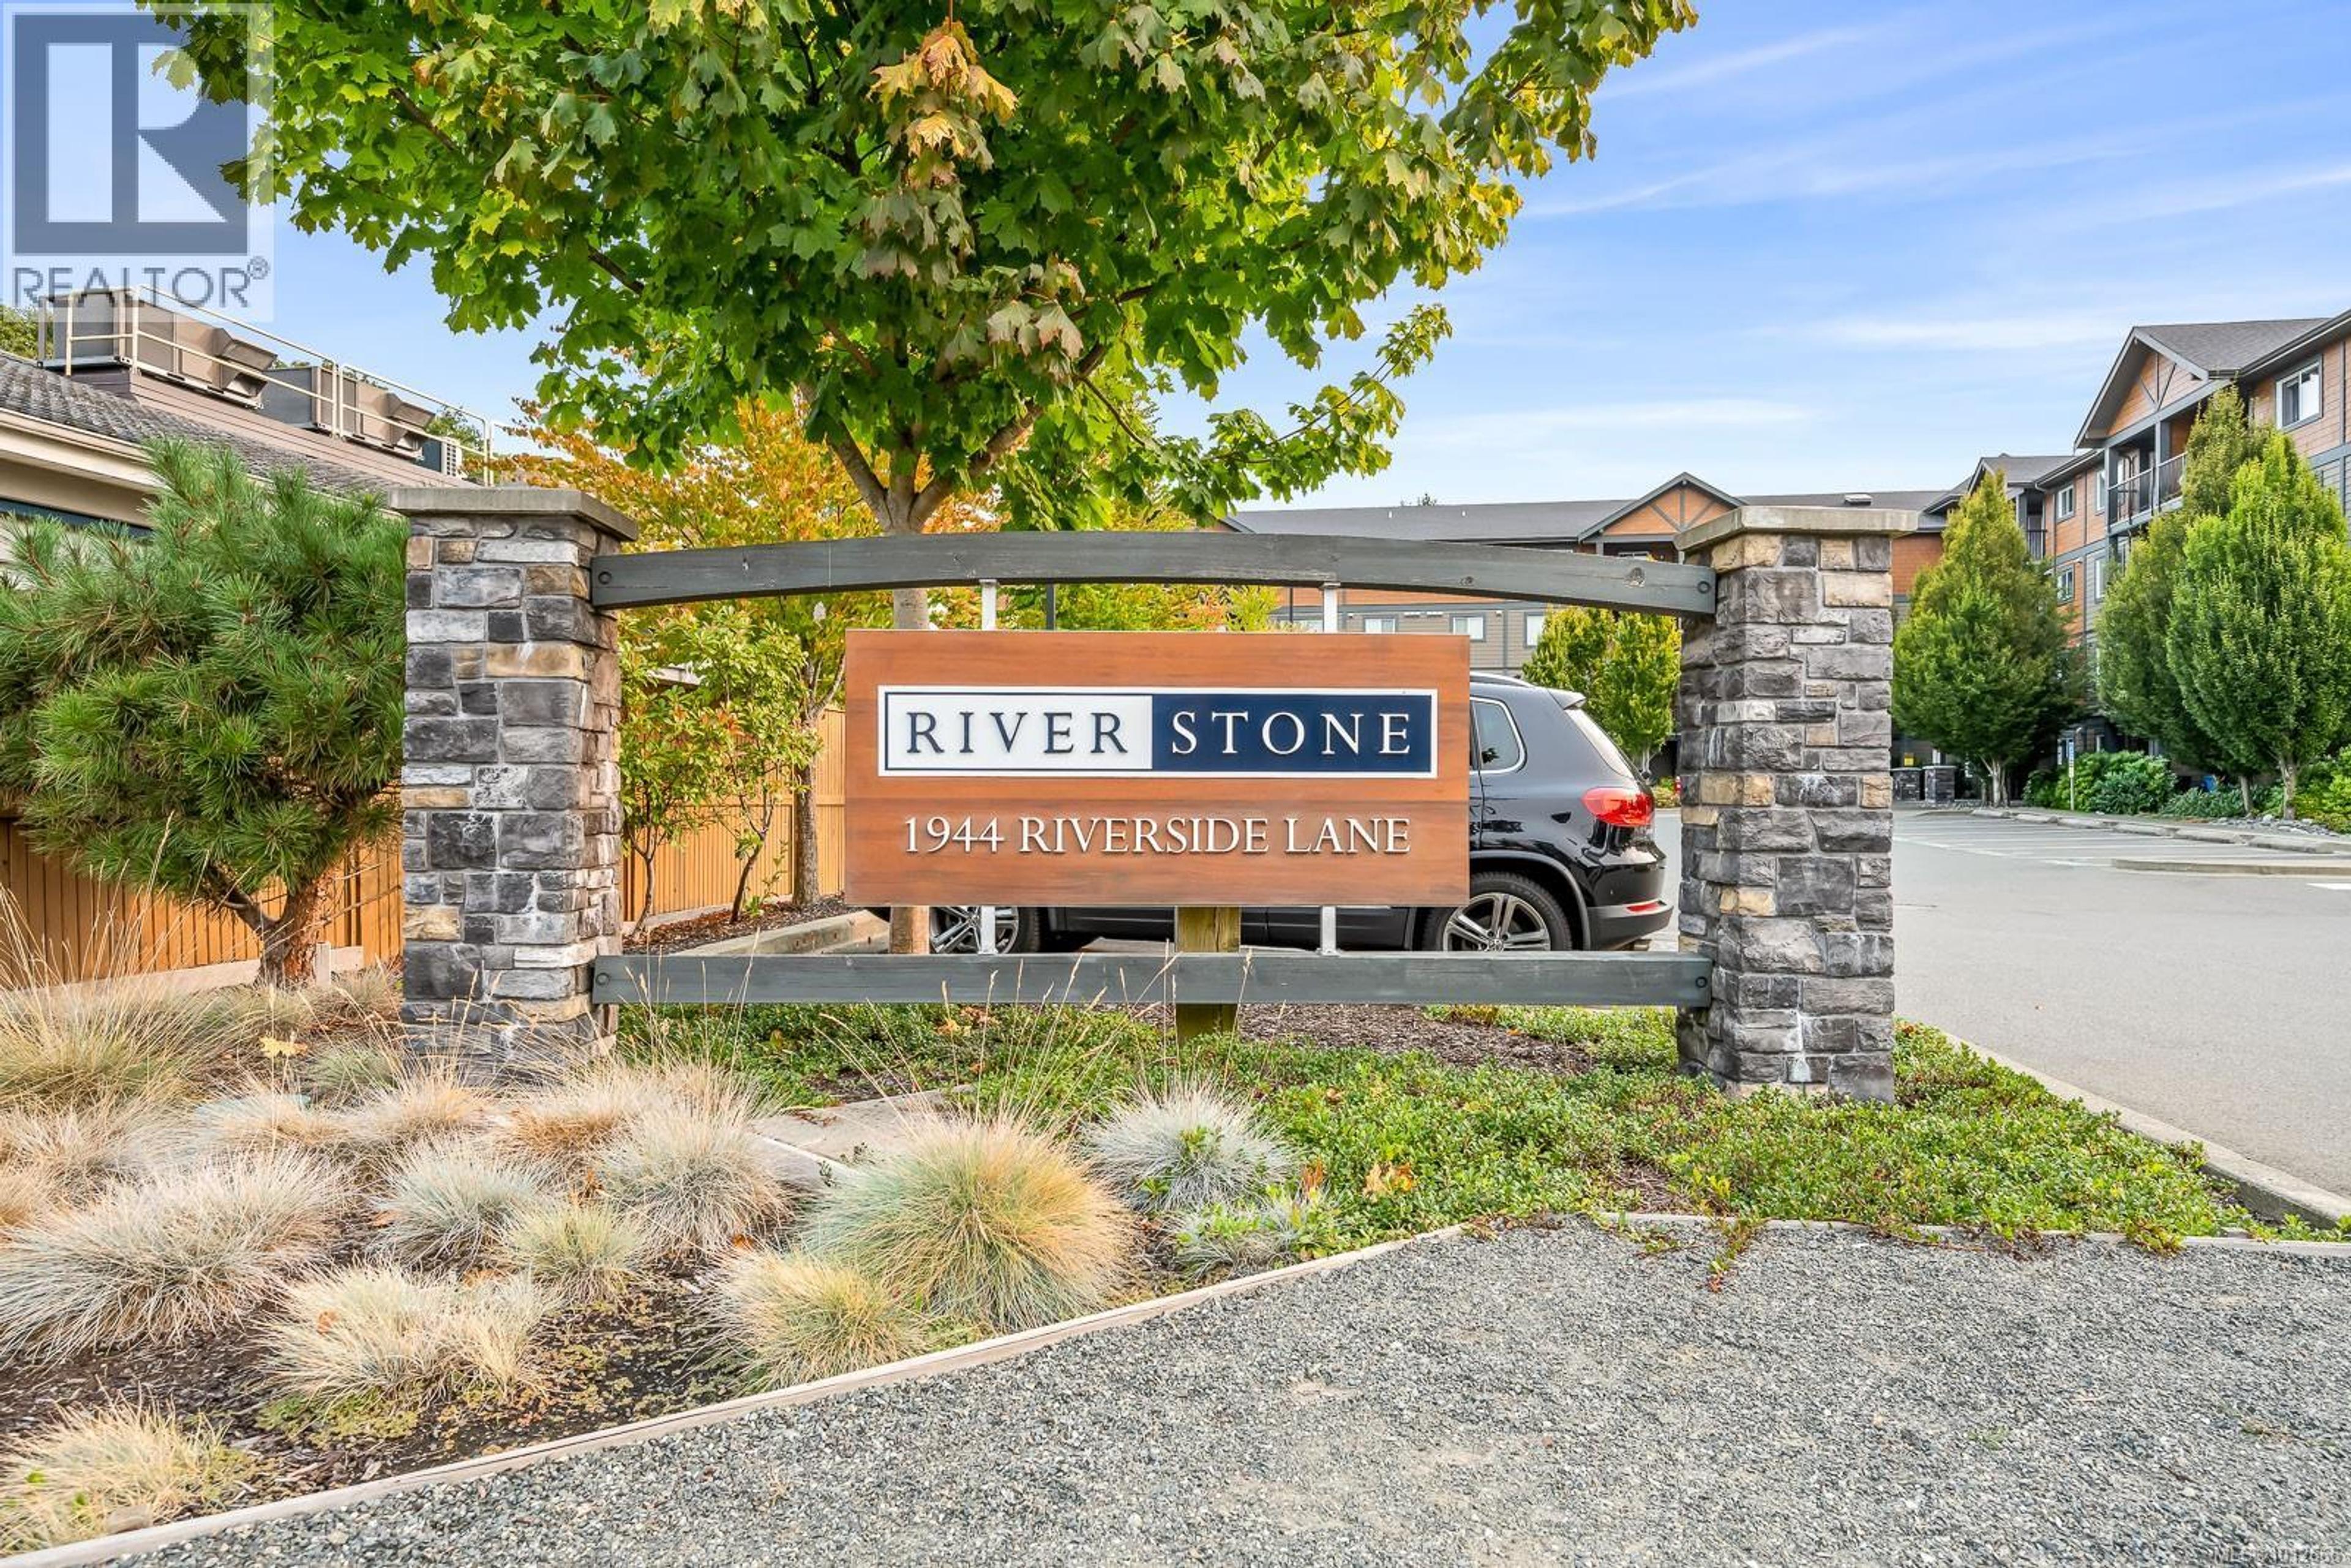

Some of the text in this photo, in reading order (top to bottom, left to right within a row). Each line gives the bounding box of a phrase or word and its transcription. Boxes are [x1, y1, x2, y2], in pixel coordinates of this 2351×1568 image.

[907, 711, 1411, 755] RIVER STONE
[905, 816, 1411, 854] 1944 RIVERSIDE LANE
